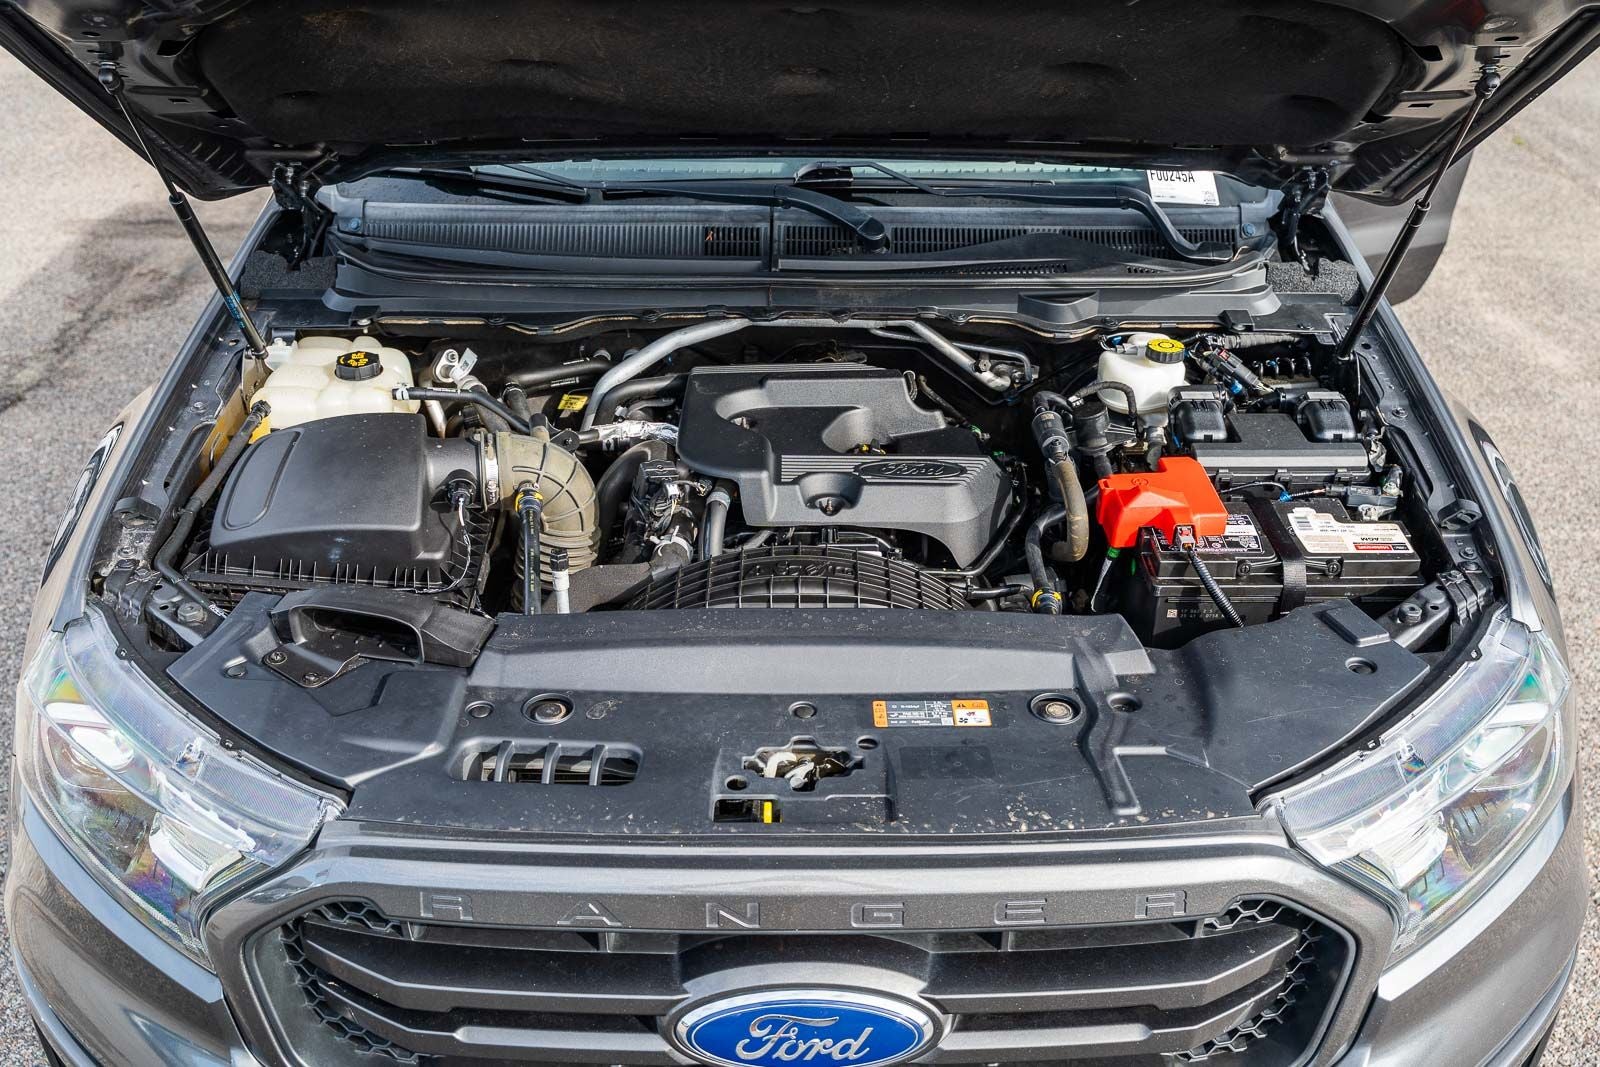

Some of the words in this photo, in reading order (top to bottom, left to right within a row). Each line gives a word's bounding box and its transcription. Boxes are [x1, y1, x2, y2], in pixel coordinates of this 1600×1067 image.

[881, 463, 944, 476] Ford
[419, 890, 1188, 929] RANGER
[735, 1013, 875, 1061] Ford
